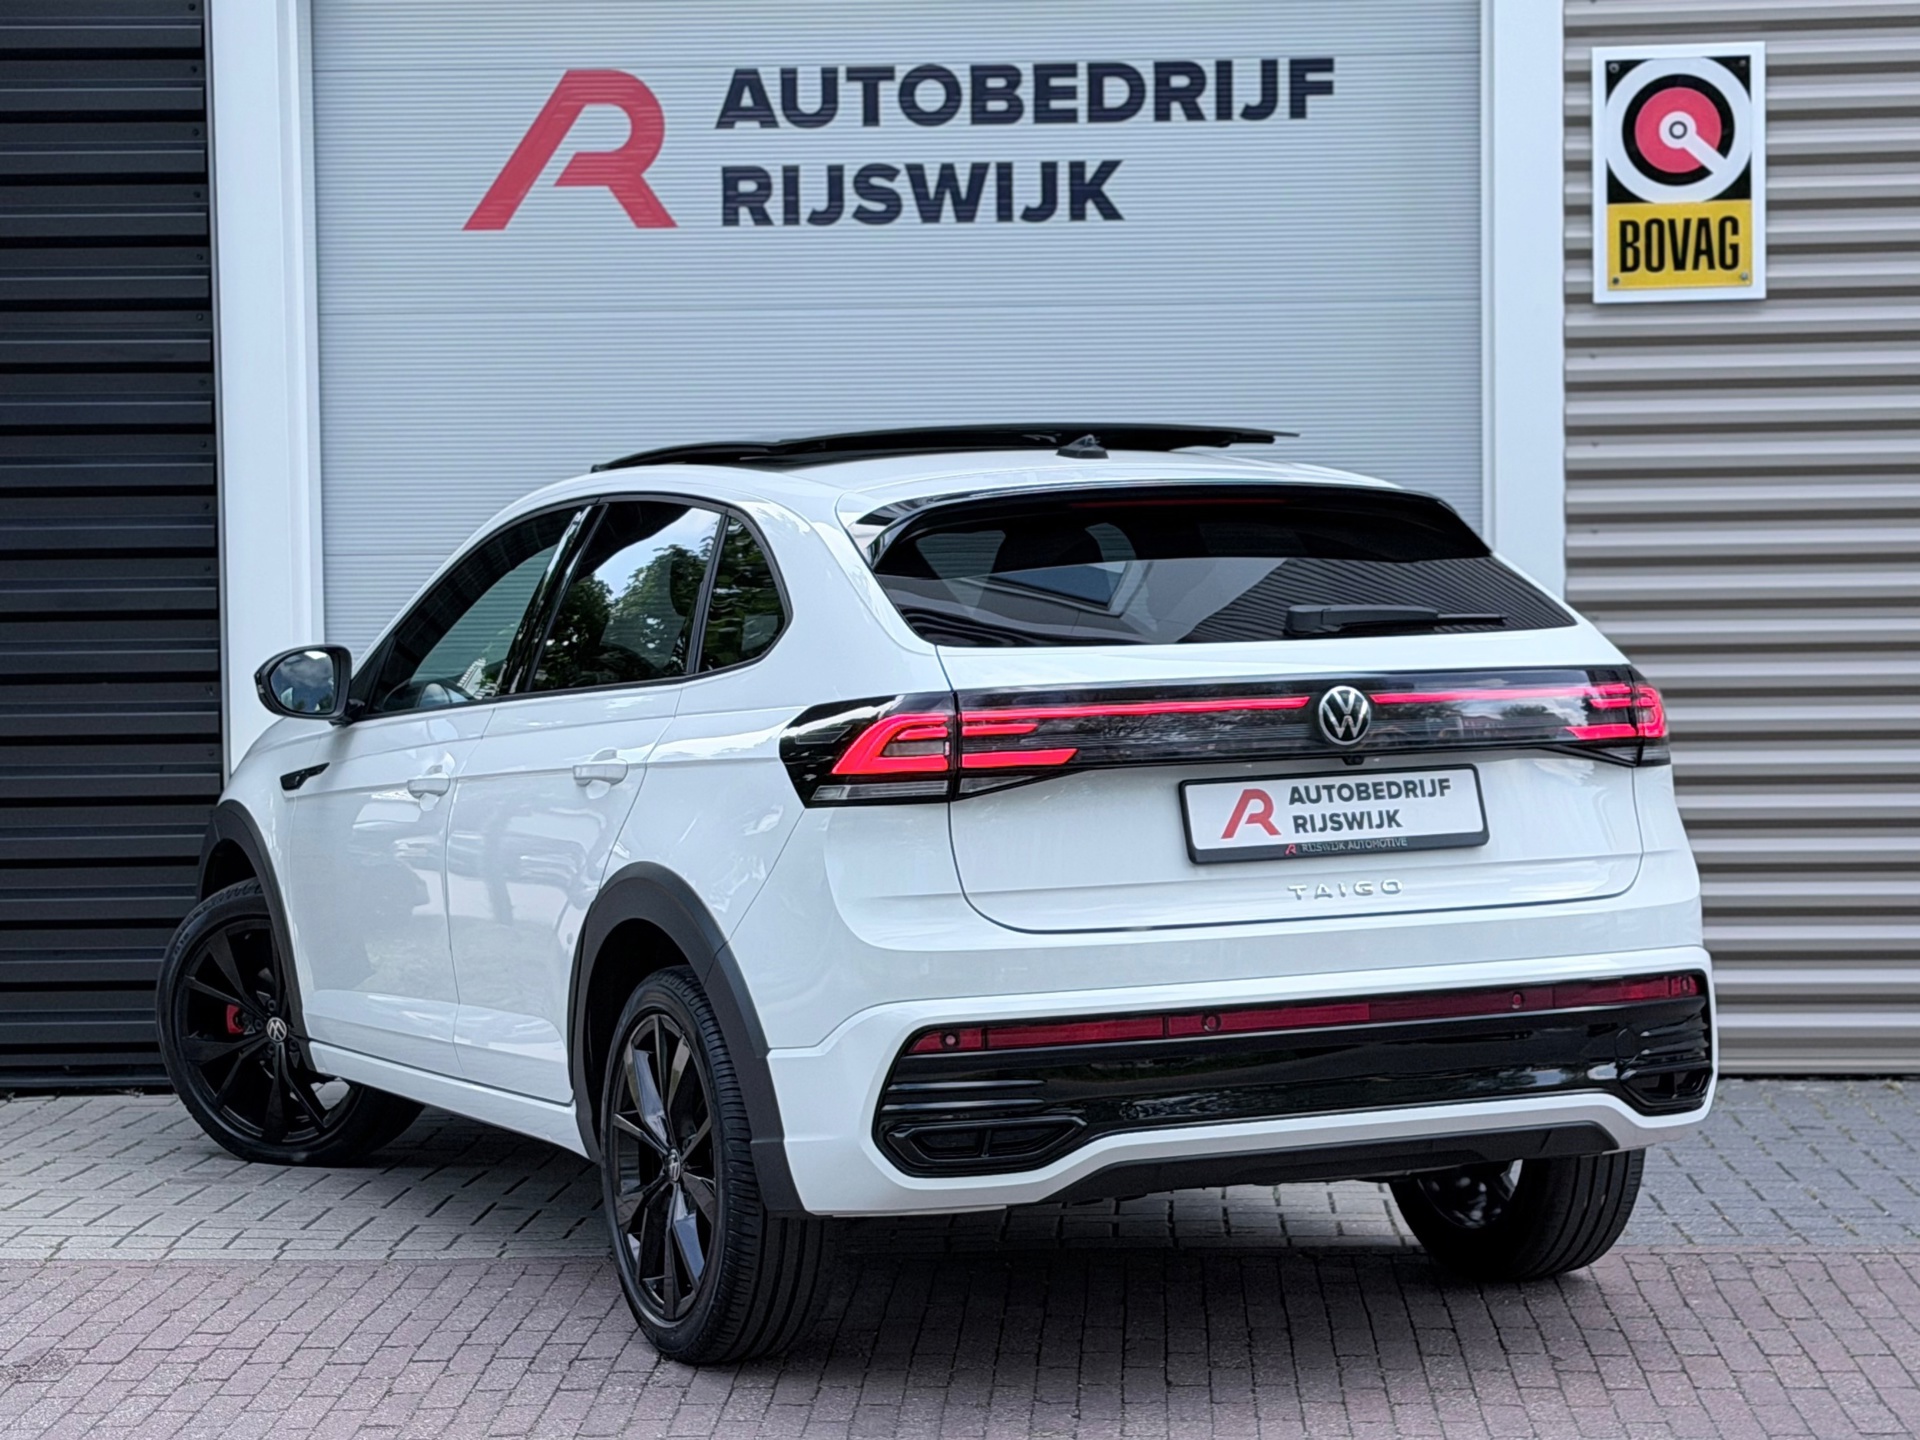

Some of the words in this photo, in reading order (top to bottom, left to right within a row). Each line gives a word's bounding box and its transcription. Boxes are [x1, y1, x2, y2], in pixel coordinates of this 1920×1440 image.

[715, 58, 1334, 129] AUTOBEDRIJF
[721, 160, 1125, 227] RIJSWIJK
[1619, 215, 1740, 273] BOVAG
[1318, 685, 1371, 745] VW
[1288, 778, 1451, 806] AUTOBEDRIJF
[1292, 809, 1404, 834] RIJSWIJK
[1301, 842, 1346, 853] RIJSWIJK
[1347, 837, 1408, 850] AUTOMOTIVE
[1287, 879, 1403, 900] TAIGO
